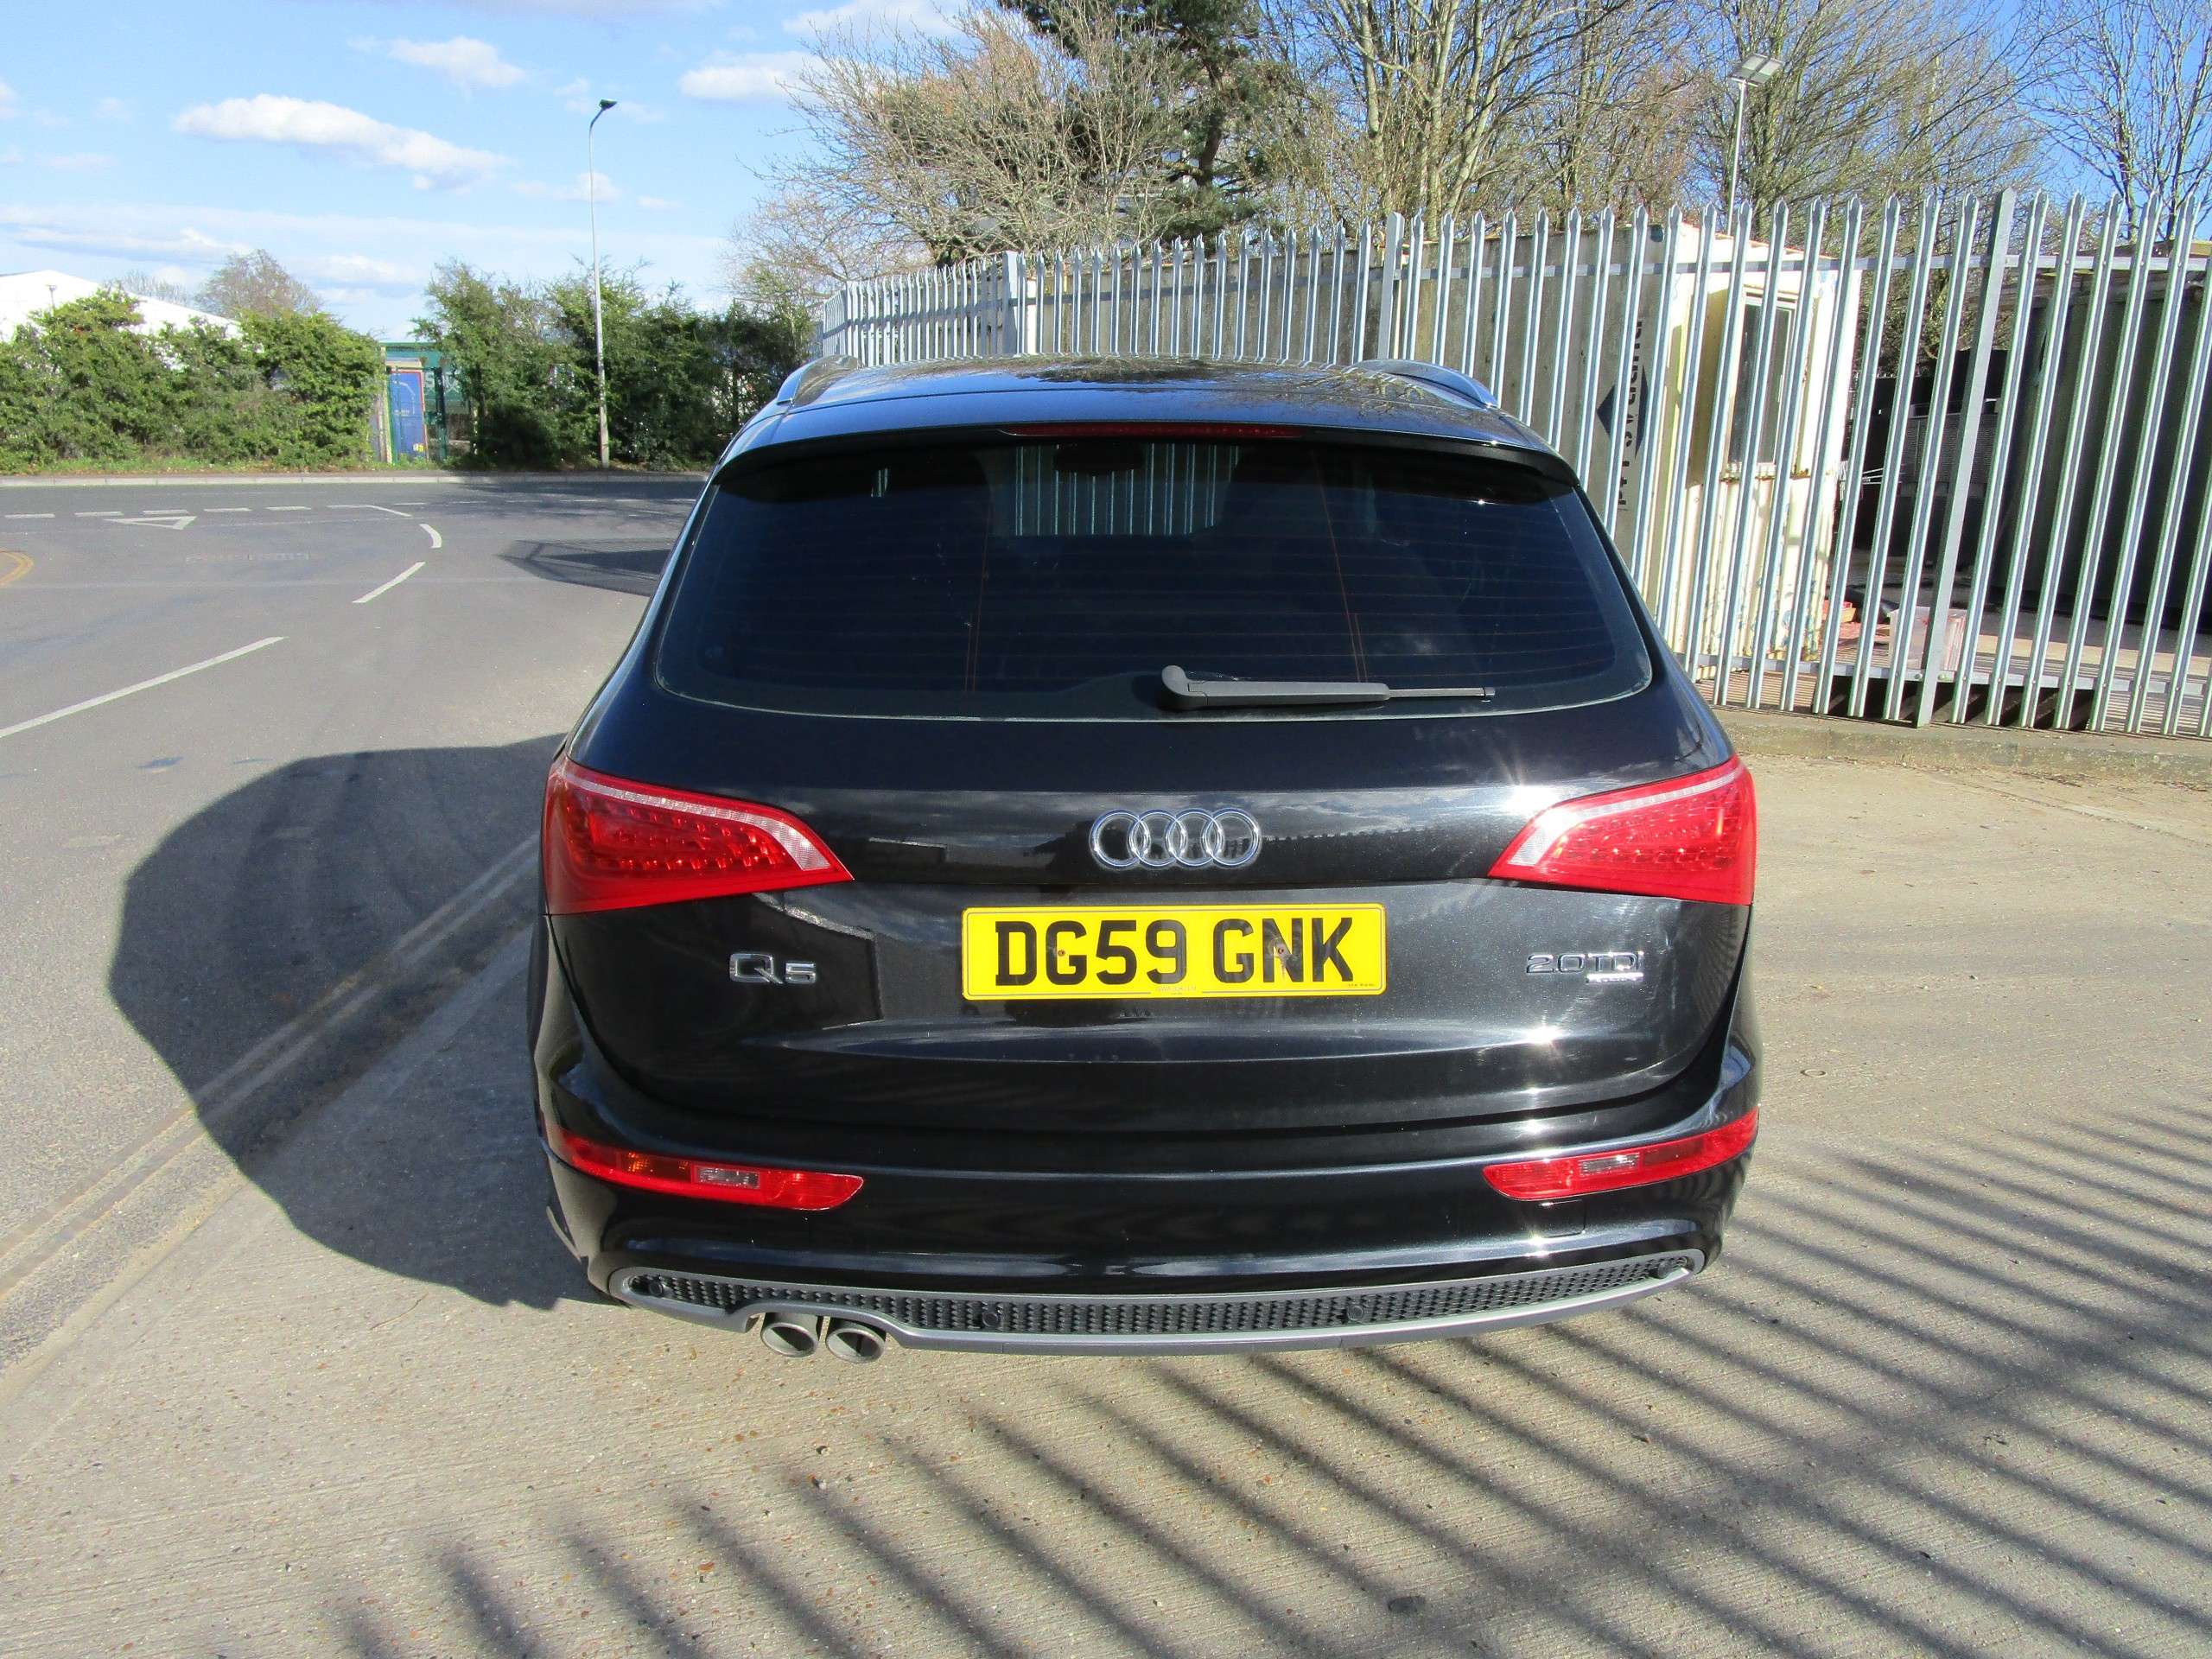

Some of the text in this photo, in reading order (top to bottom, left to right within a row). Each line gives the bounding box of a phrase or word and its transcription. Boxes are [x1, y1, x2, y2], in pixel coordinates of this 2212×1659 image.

[728, 953, 817, 984] Q5
[995, 917, 1354, 987] DG59 GNK
